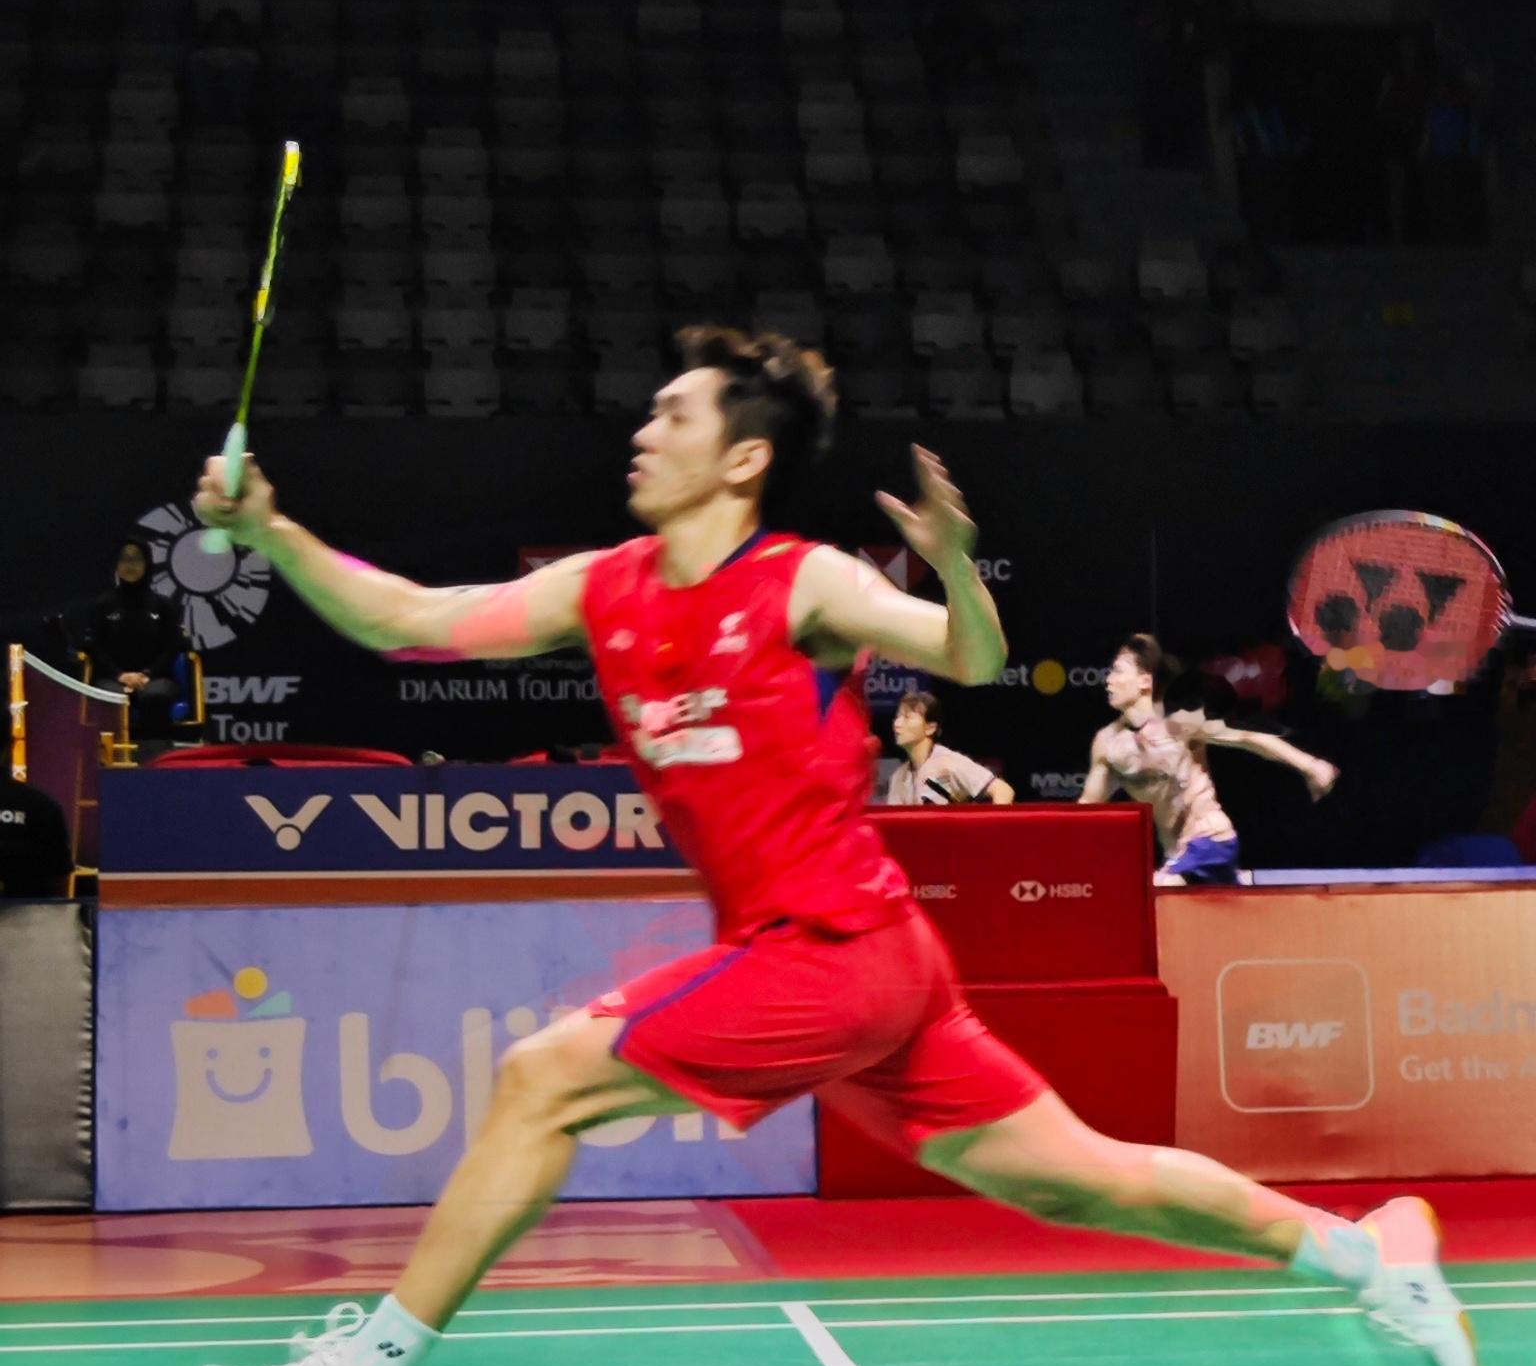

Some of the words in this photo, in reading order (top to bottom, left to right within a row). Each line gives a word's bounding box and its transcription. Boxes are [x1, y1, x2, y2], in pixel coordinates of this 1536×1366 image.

[203, 675, 302, 705] BWF
[400, 678, 508, 703] DJARUM
[517, 672, 600, 701] found
[212, 714, 289, 743] Tour
[0, 809, 26, 825] OR
[351, 791, 665, 851] VICTOR
[1051, 883, 1094, 899] HSBC
[1246, 1020, 1345, 1050] BWF
[1400, 1054, 1454, 1082] Get
[1461, 1054, 1510, 1081] the
